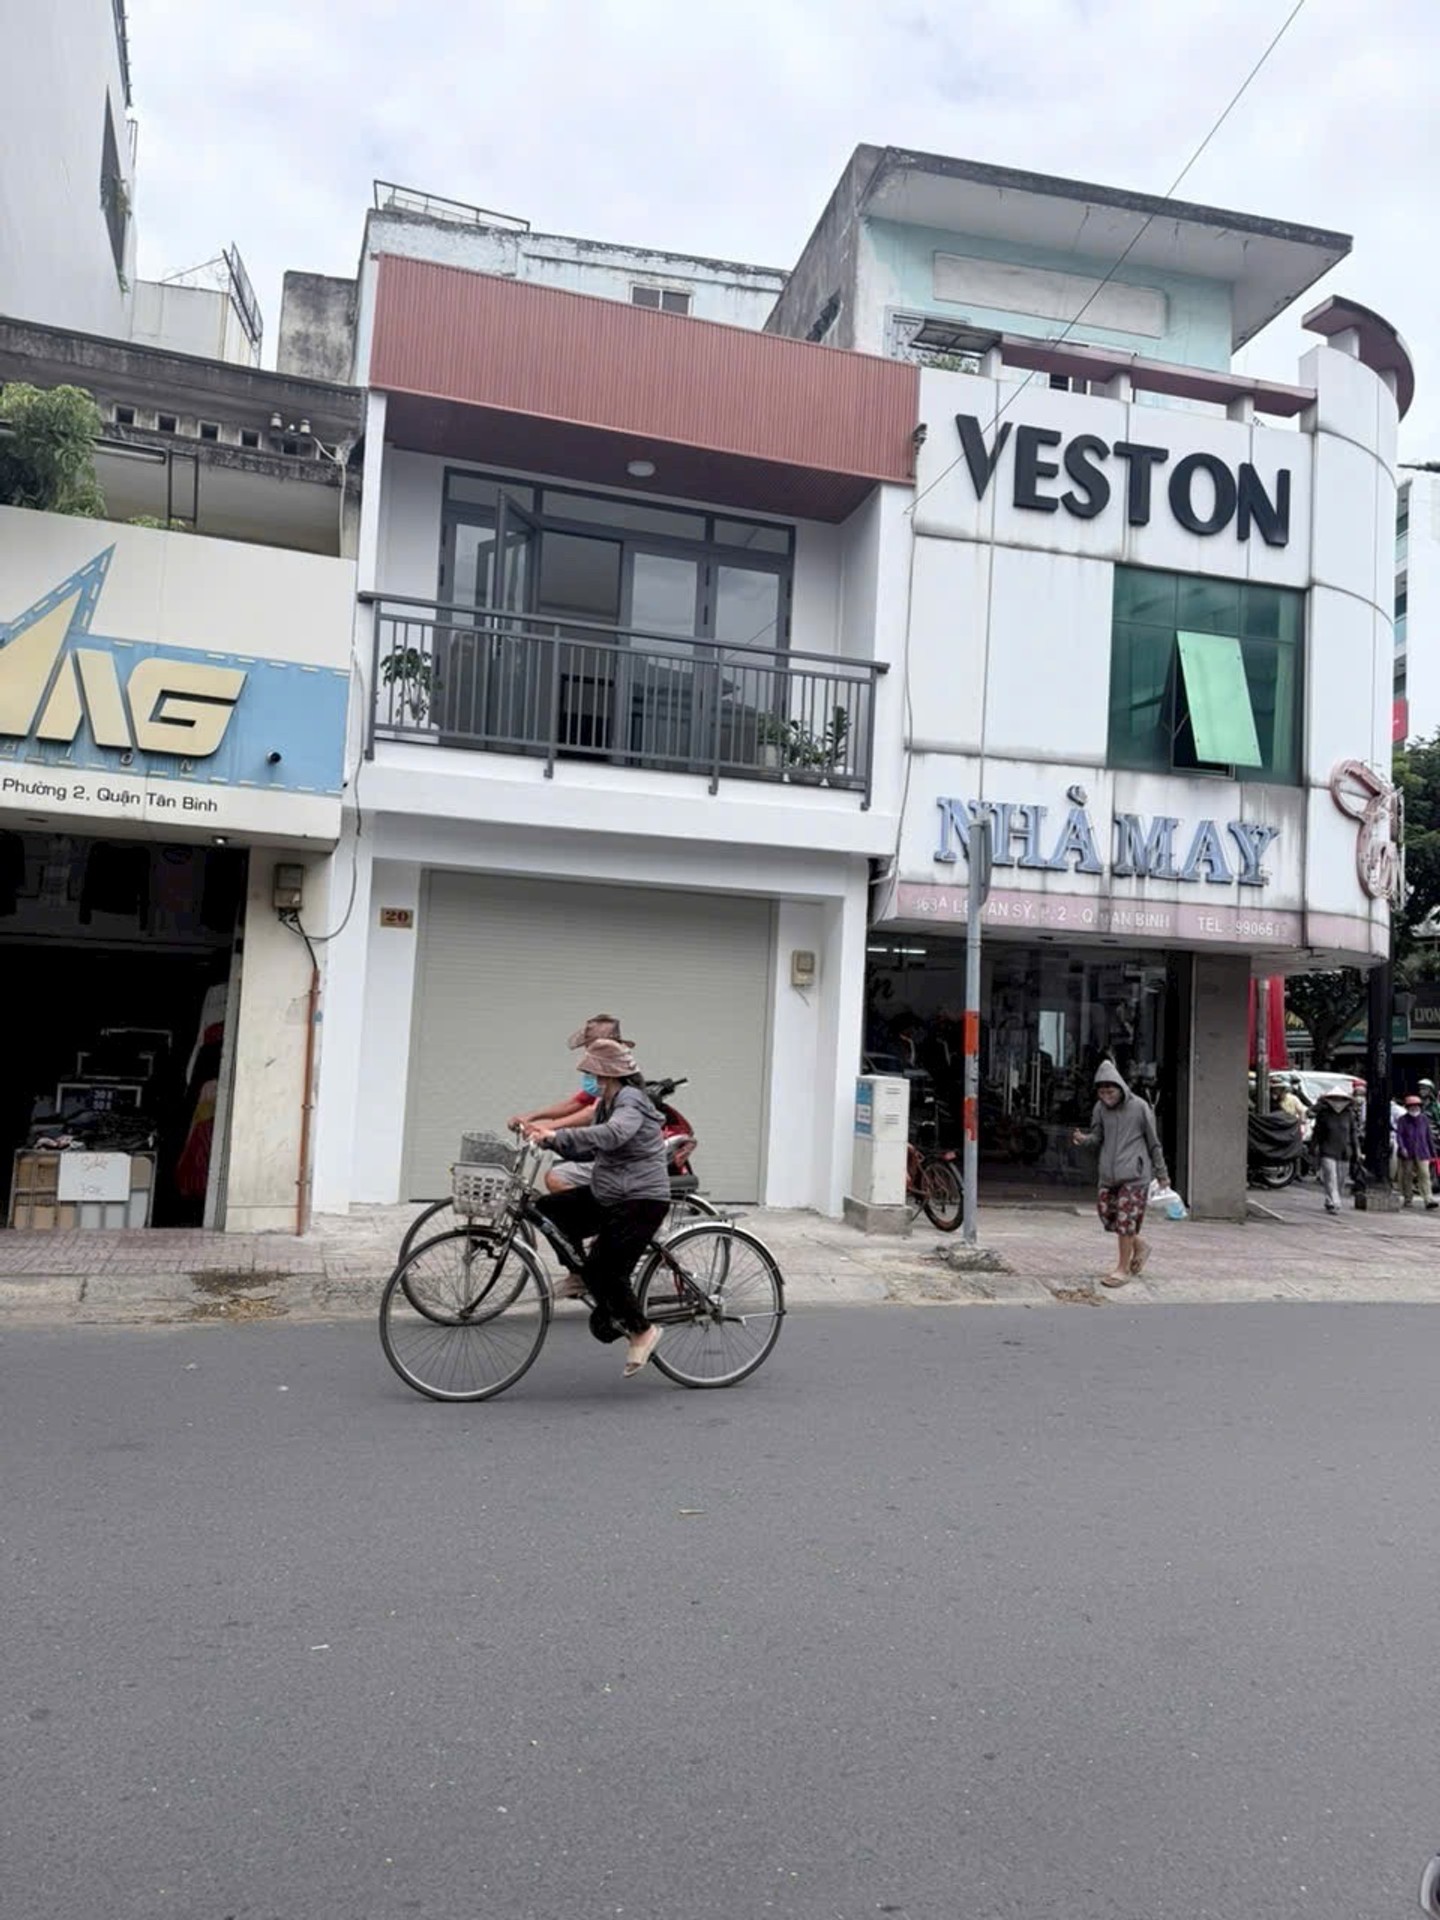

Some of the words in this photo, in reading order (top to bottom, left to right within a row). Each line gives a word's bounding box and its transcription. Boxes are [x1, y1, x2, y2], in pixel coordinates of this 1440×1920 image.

[955, 413, 1291, 547] VESTON
[3, 778, 67, 801] Phường
[97, 787, 140, 806] Quận
[146, 791, 176, 808] Tân
[183, 796, 218, 812] Bình
[1112, 812, 1280, 887] MAY
[385, 910, 409, 923] 20
